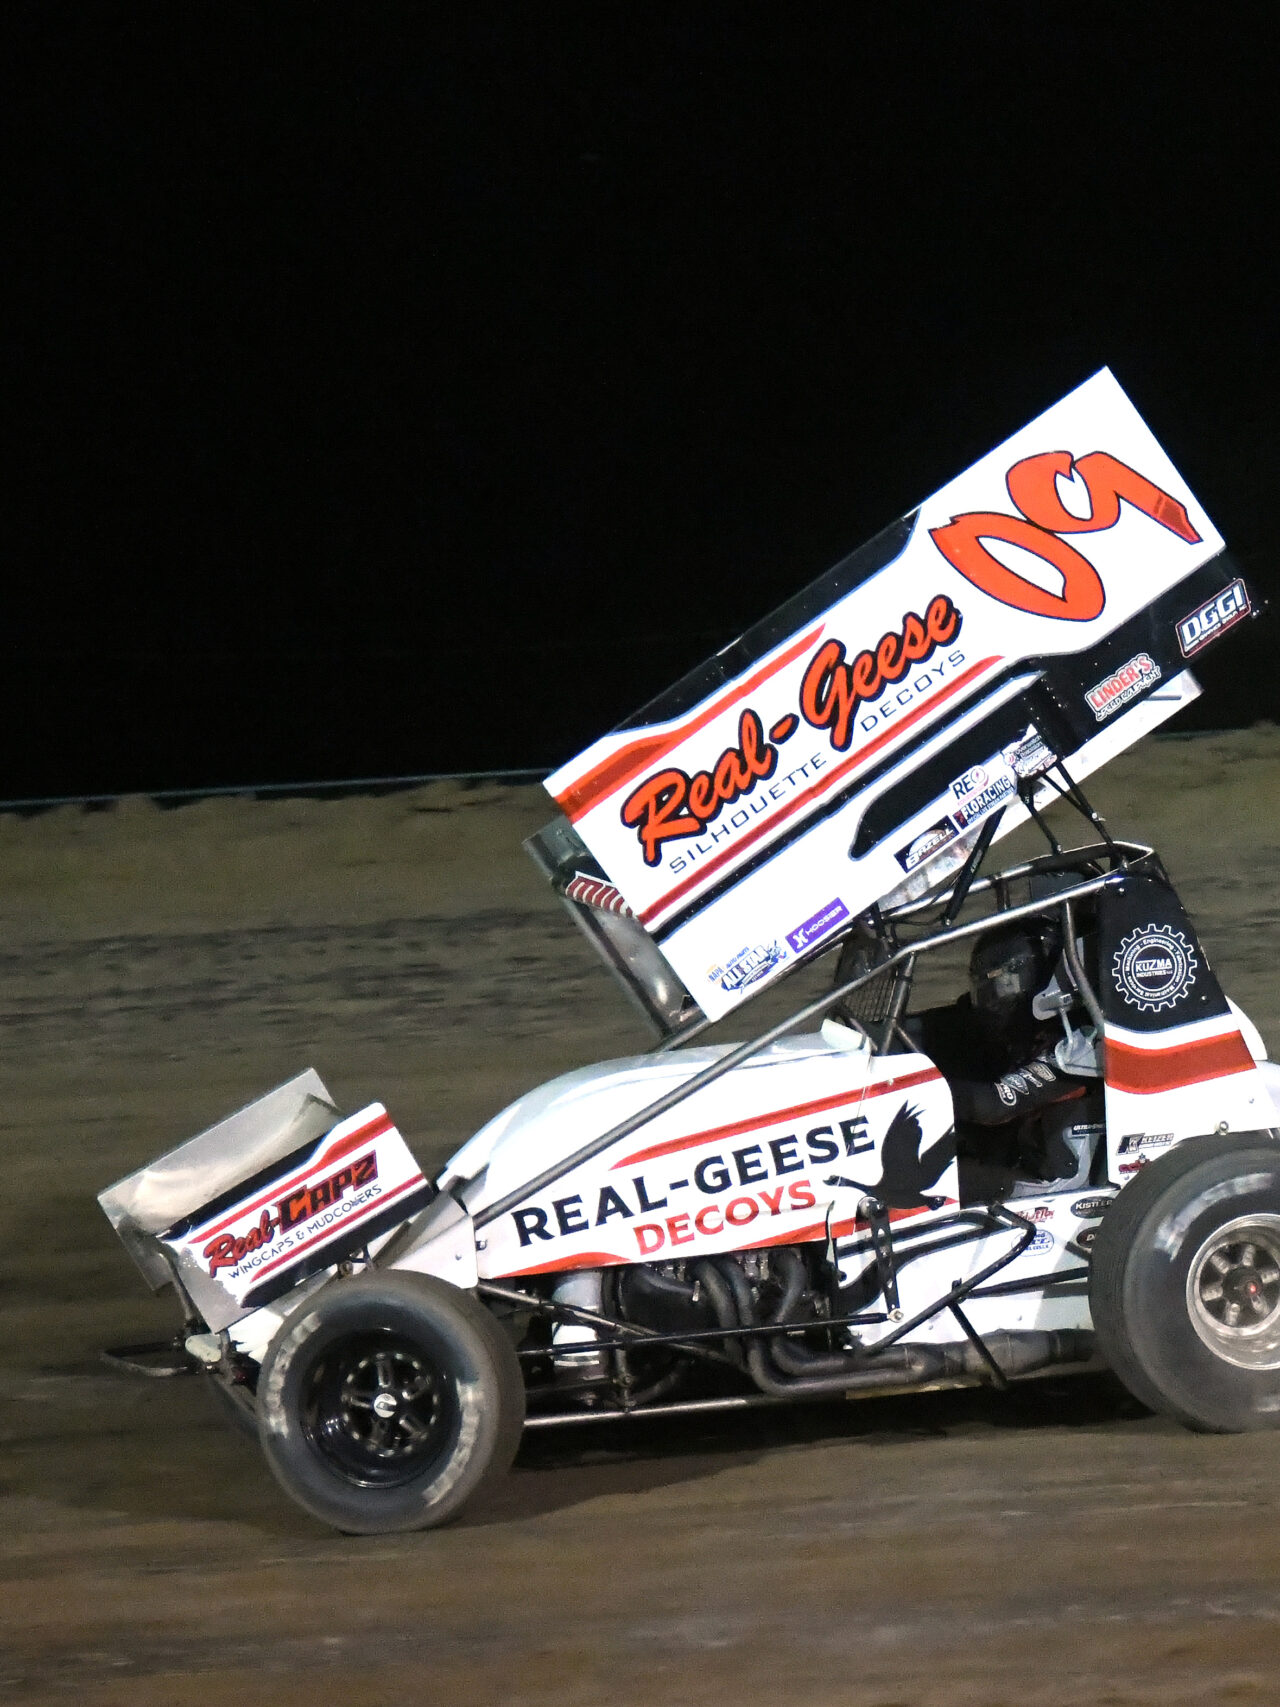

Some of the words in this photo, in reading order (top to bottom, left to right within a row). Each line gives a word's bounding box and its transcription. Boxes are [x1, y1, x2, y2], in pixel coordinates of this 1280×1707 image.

[929, 450, 1204, 622] 09
[621, 594, 964, 867] Real-Geese
[669, 752, 827, 874] SILHOUETTE
[861, 650, 966, 732] DECOYS
[962, 775, 1012, 821] FLORACING
[806, 906, 843, 935] HOOSIER
[1135, 958, 1173, 972] KUZMA
[511, 1116, 876, 1248] REAL-GEESE
[633, 1179, 817, 1256] DECOYS
[228, 1237, 294, 1279] WINGCAPS
[295, 1230, 304, 1241] &
[307, 1184, 382, 1235] MUDCOVERS
